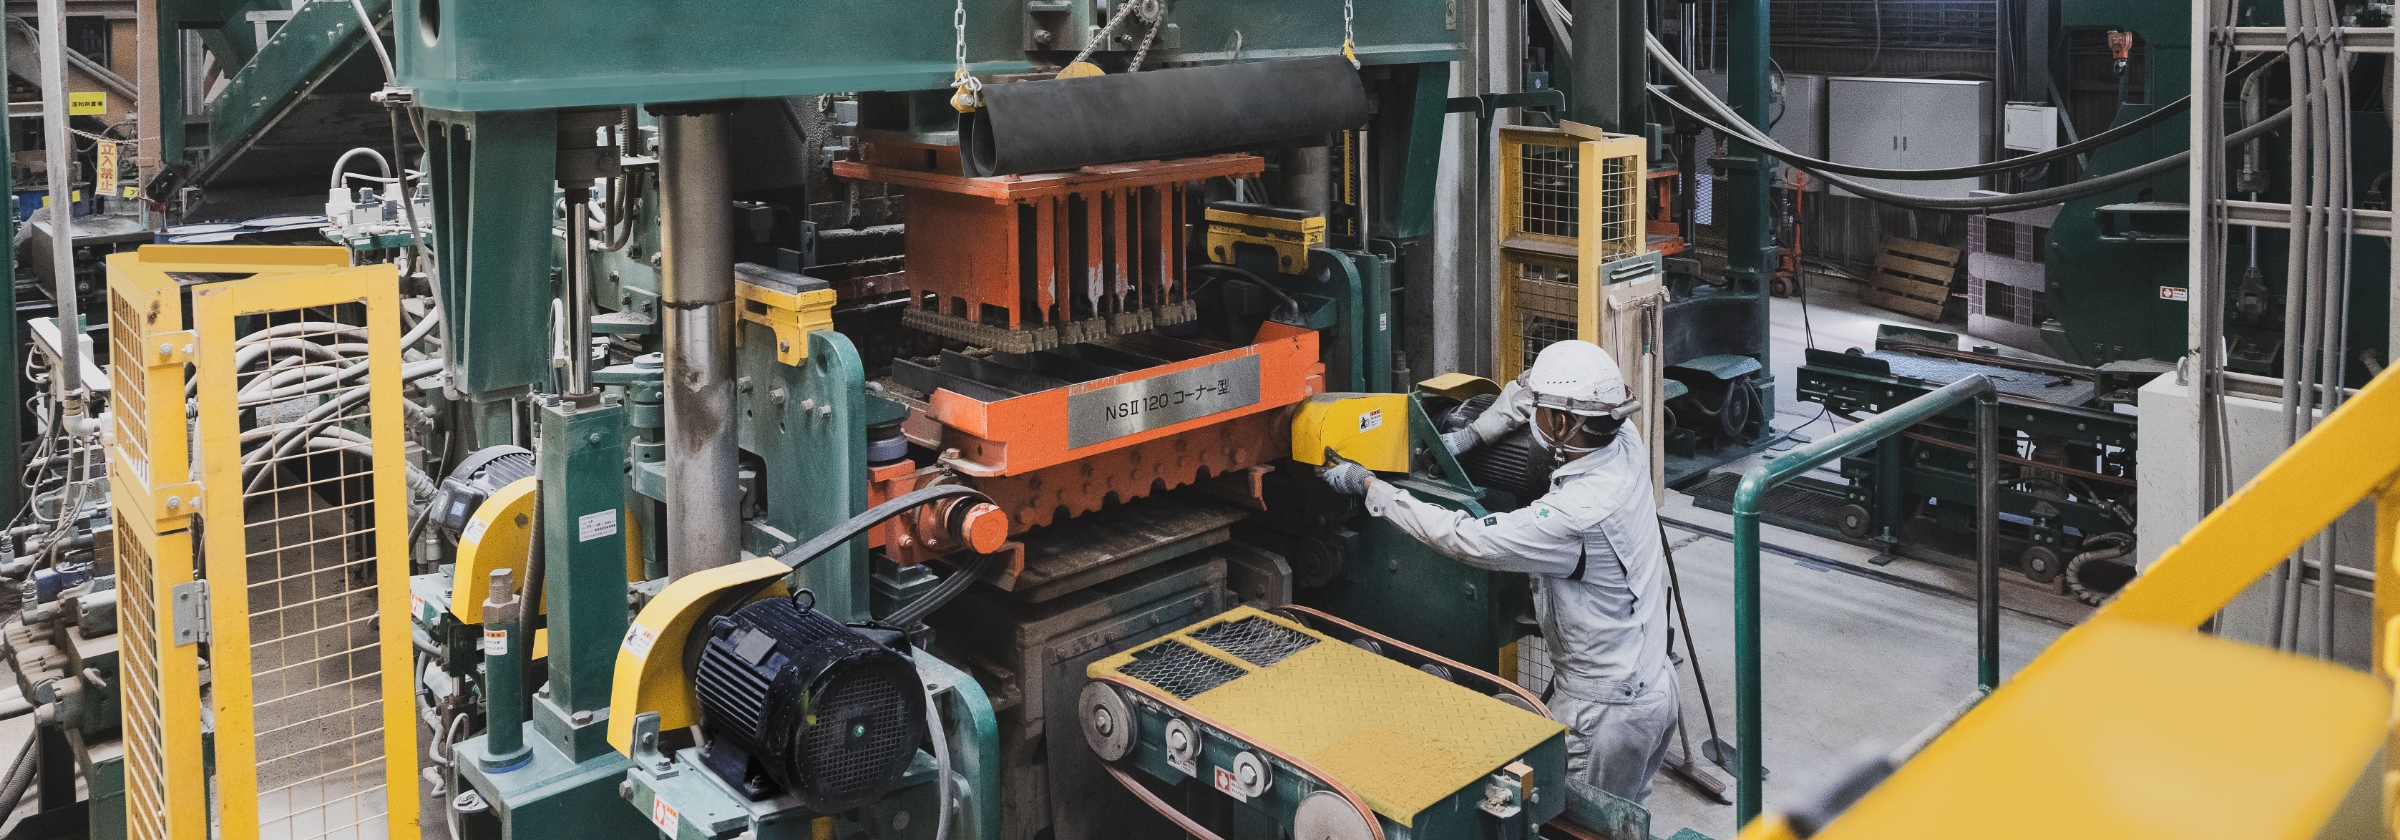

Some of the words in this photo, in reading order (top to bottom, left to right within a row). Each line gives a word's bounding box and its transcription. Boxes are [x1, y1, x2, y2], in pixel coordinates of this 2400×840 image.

[100, 144, 114, 191] 立入禁止
[1143, 393, 1168, 412] 120
[1173, 378, 1229, 405] コーナー型
